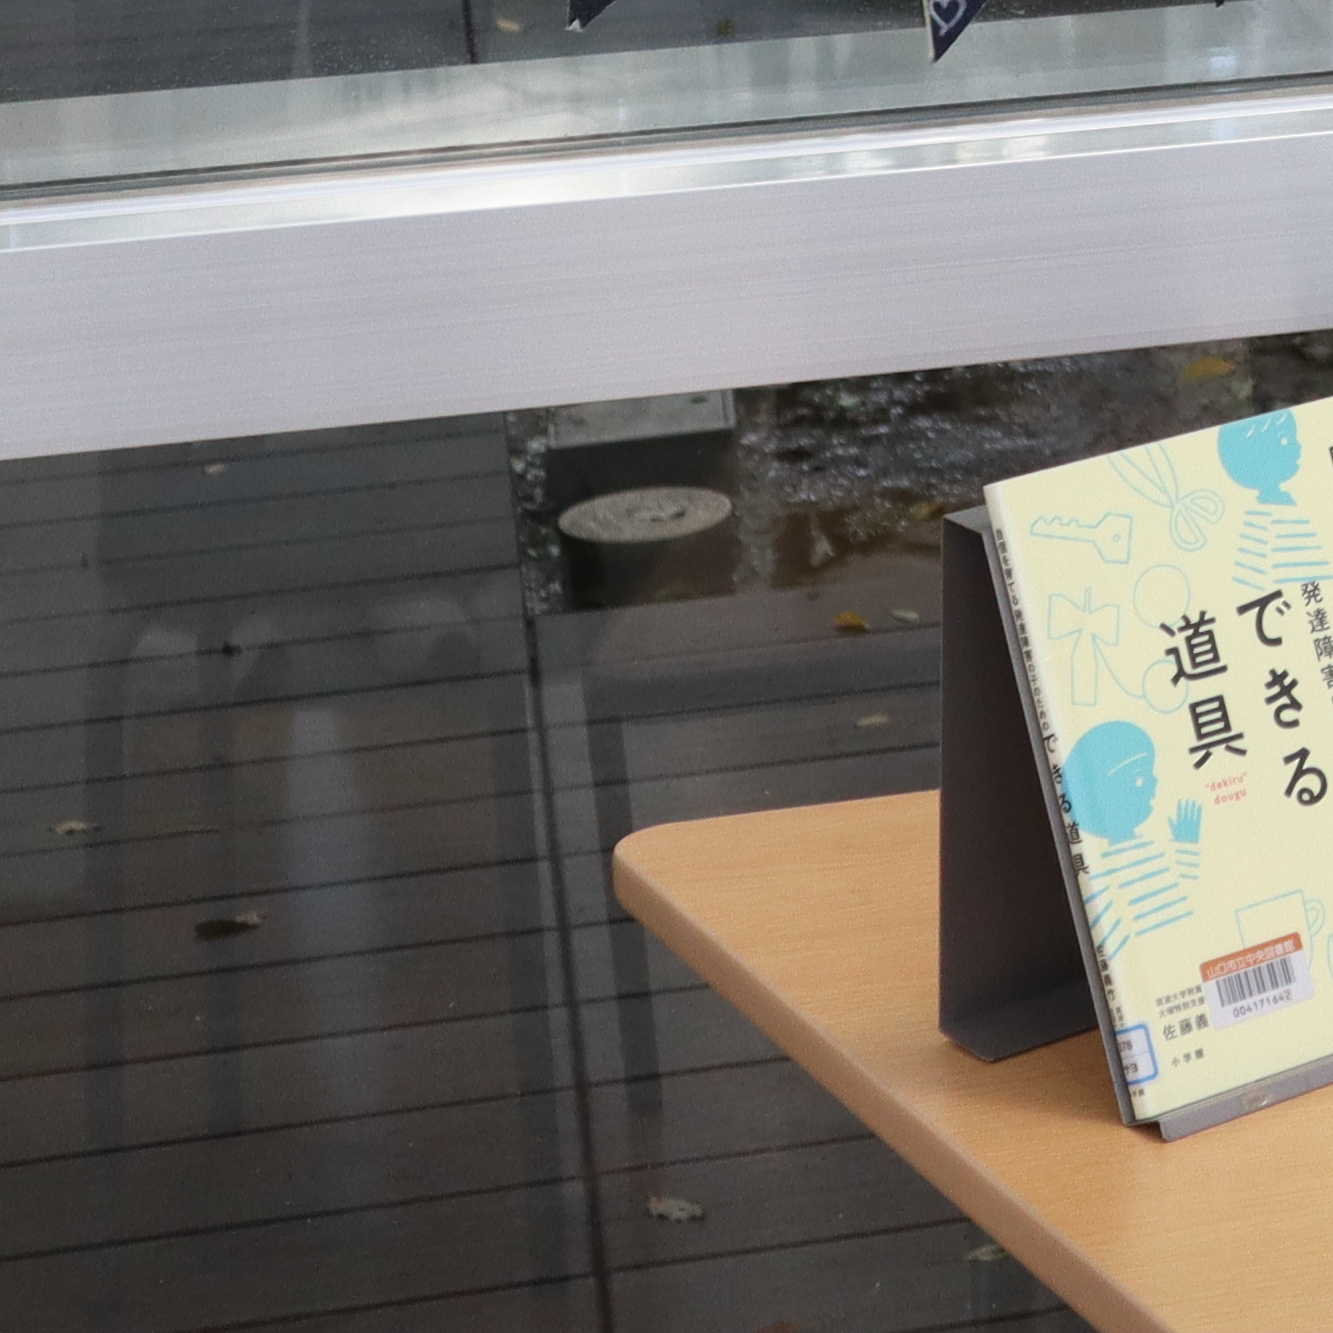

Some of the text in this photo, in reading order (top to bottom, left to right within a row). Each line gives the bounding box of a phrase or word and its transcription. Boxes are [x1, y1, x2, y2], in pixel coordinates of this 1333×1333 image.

[1157, 608, 1250, 772] 道具
[1235, 588, 1330, 808] できる
[1212, 787, 1249, 808] dougu
[1205, 938, 1297, 980] 山口市立中央図書館
